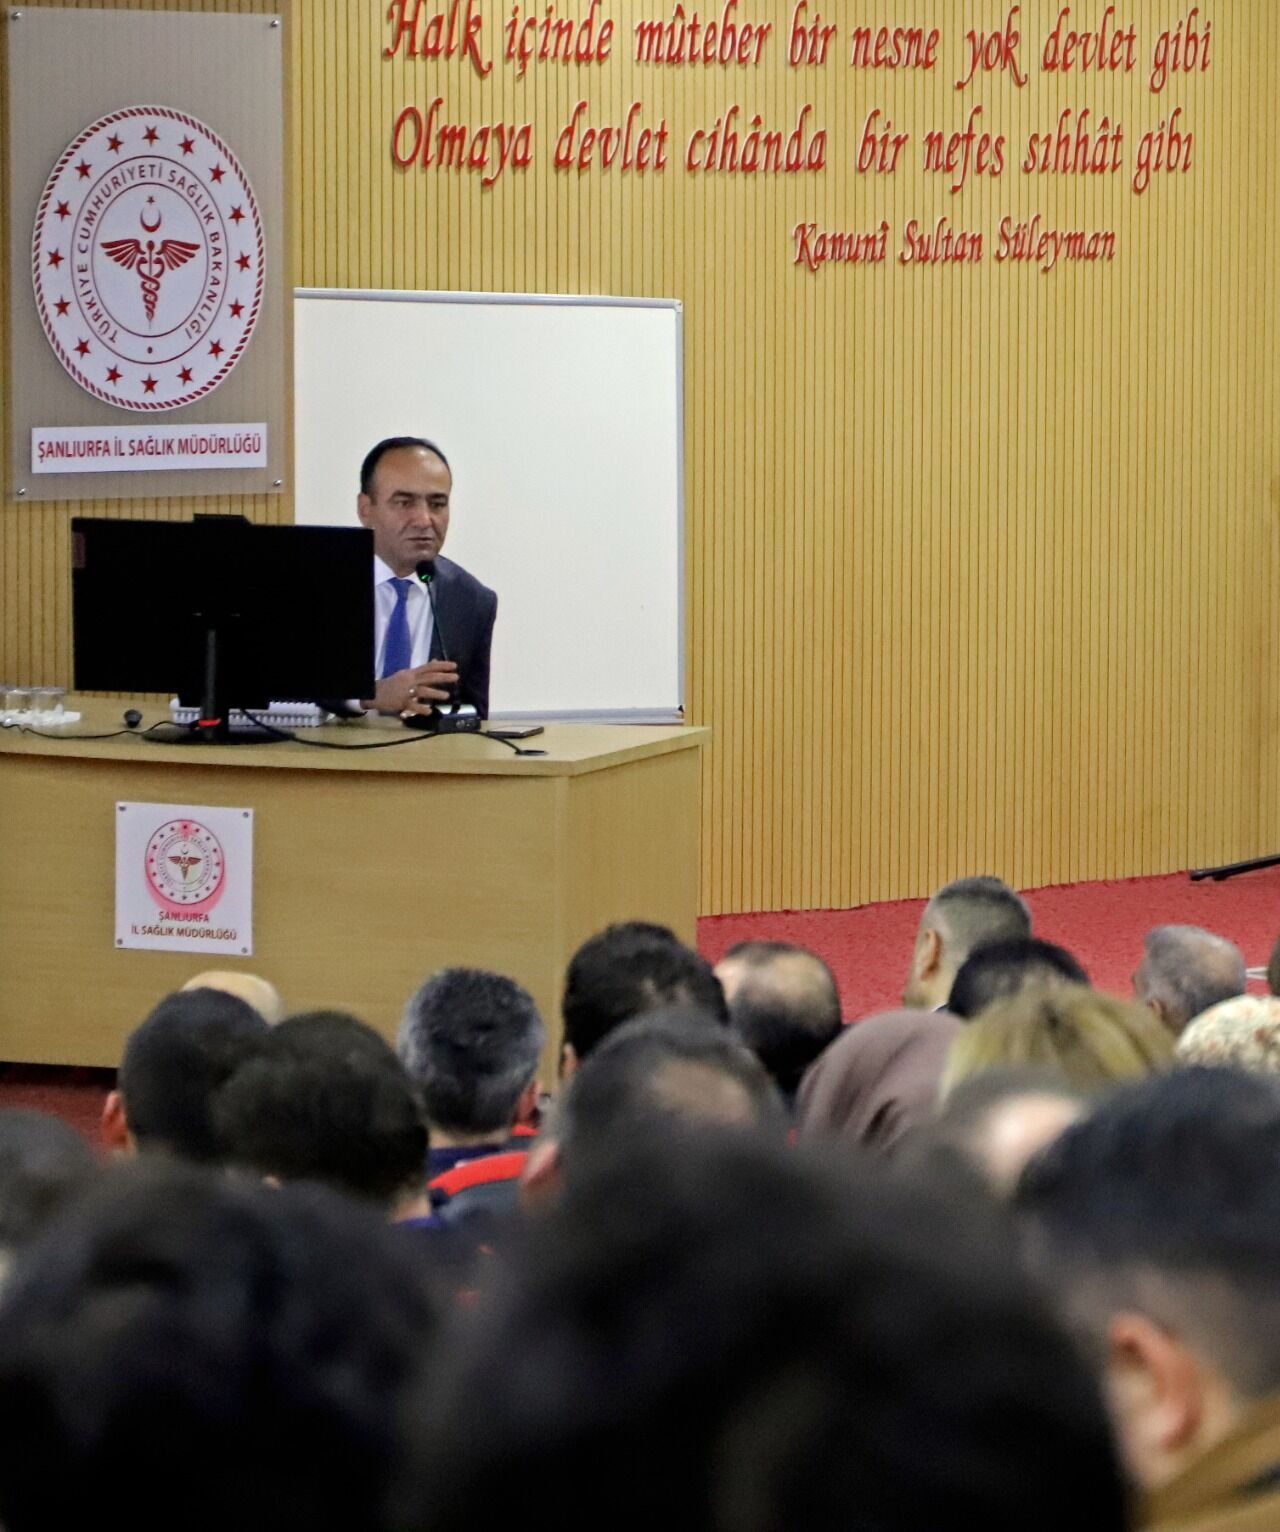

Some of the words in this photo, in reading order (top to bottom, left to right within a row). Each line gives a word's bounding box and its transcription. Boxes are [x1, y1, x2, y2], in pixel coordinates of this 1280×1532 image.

[383, 0, 493, 75] Halk
[505, 0, 614, 76] içinde
[788, 0, 837, 67] bir
[851, 23, 940, 69] nesne
[955, 5, 1028, 90] yok
[1041, 6, 1136, 73] devlet
[1150, 8, 1212, 93] gibi
[392, 97, 533, 187] Olmaya
[554, 101, 668, 172] devlet
[686, 104, 827, 173] cihânda
[857, 108, 908, 174] bir
[924, 105, 1006, 194] nefes
[167, 169, 216, 226] SAĞLIK
[900, 216, 984, 264] Sultan
[995, 214, 1116, 273] Süleyman
[184, 231, 224, 340] BAKANLIĞI
[38, 440, 111, 463] ŞANLIURFA
[114, 436, 125, 457] İL
[128, 435, 175, 456] SAĞLIK
[178, 433, 261, 455] MÜDÜRLÜĞÜ
[141, 924, 174, 936] SAĞLIK
